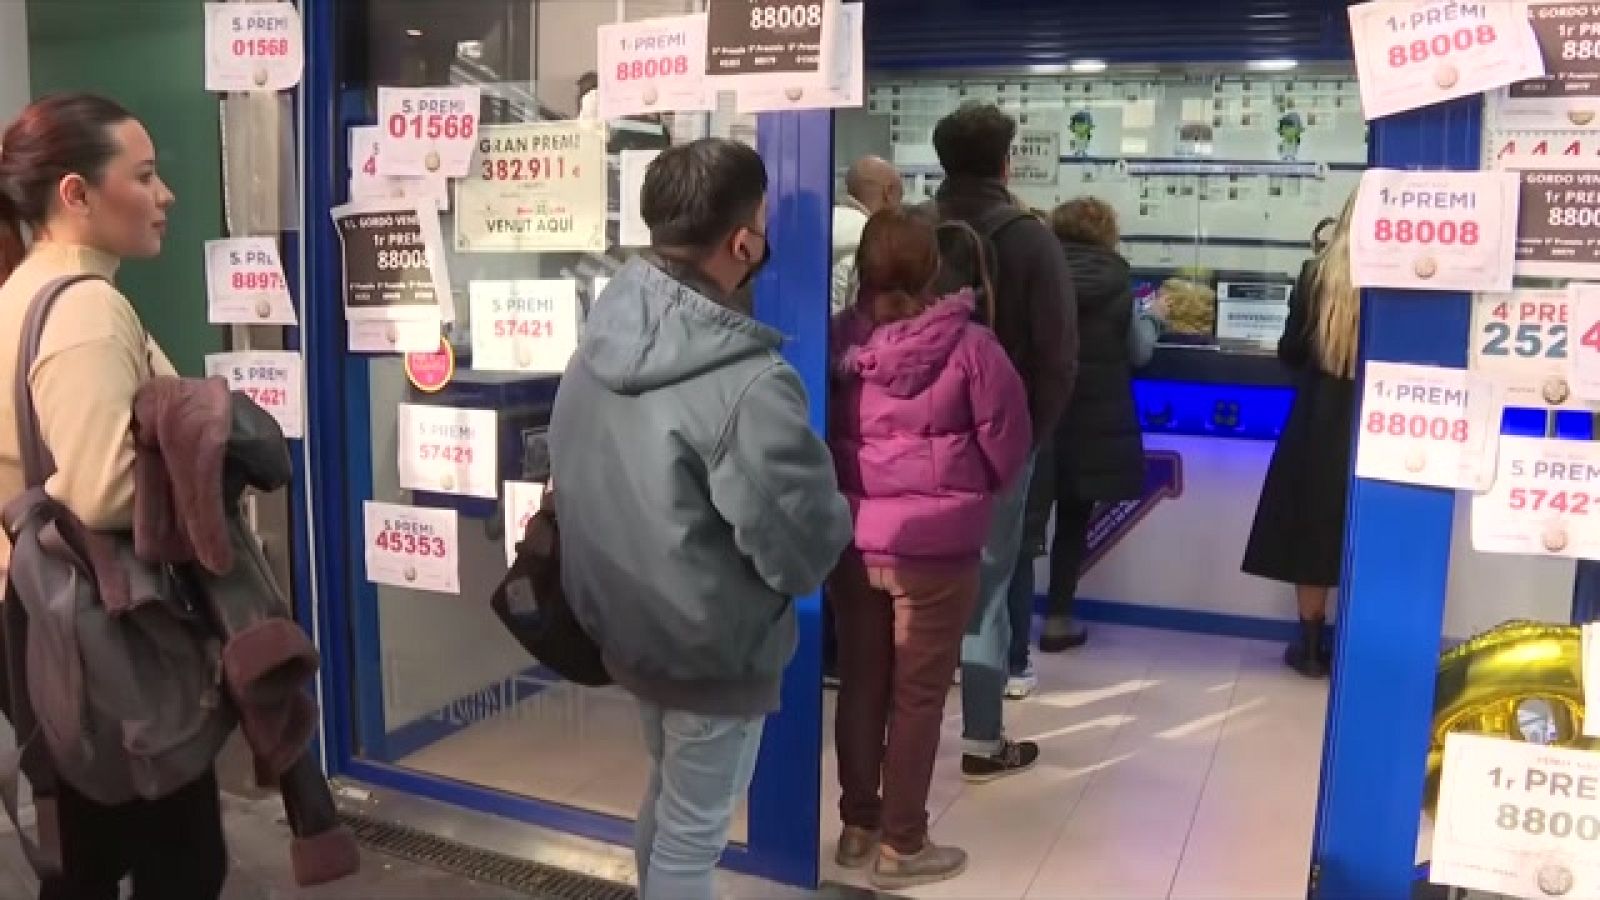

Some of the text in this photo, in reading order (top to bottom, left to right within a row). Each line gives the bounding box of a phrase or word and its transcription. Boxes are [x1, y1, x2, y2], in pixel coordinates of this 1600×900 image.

[247, 18, 288, 30] PREMI
[750, 5, 821, 29] 88008
[1411, 3, 1486, 29] PREMI
[232, 40, 288, 56] 01568
[634, 32, 686, 50] PREMI
[1388, 25, 1497, 68] 88008
[617, 55, 688, 81] 88008
[420, 100, 466, 112] PREMI
[389, 114, 474, 139] 01568
[482, 157, 563, 181] 382.911
[1526, 173, 1574, 184] GORDO
[1401, 191, 1476, 209] PREMI
[1564, 190, 1600, 204] PRE
[1374, 218, 1480, 245] 88008
[506, 297, 554, 314] PREMI
[494, 319, 555, 338] 57421
[1480, 321, 1568, 358] 252
[243, 386, 286, 406] 7421
[1396, 384, 1469, 409] PREMI
[1367, 410, 1469, 443] 88008
[419, 444, 473, 464] 57421
[375, 531, 447, 558] 45353
